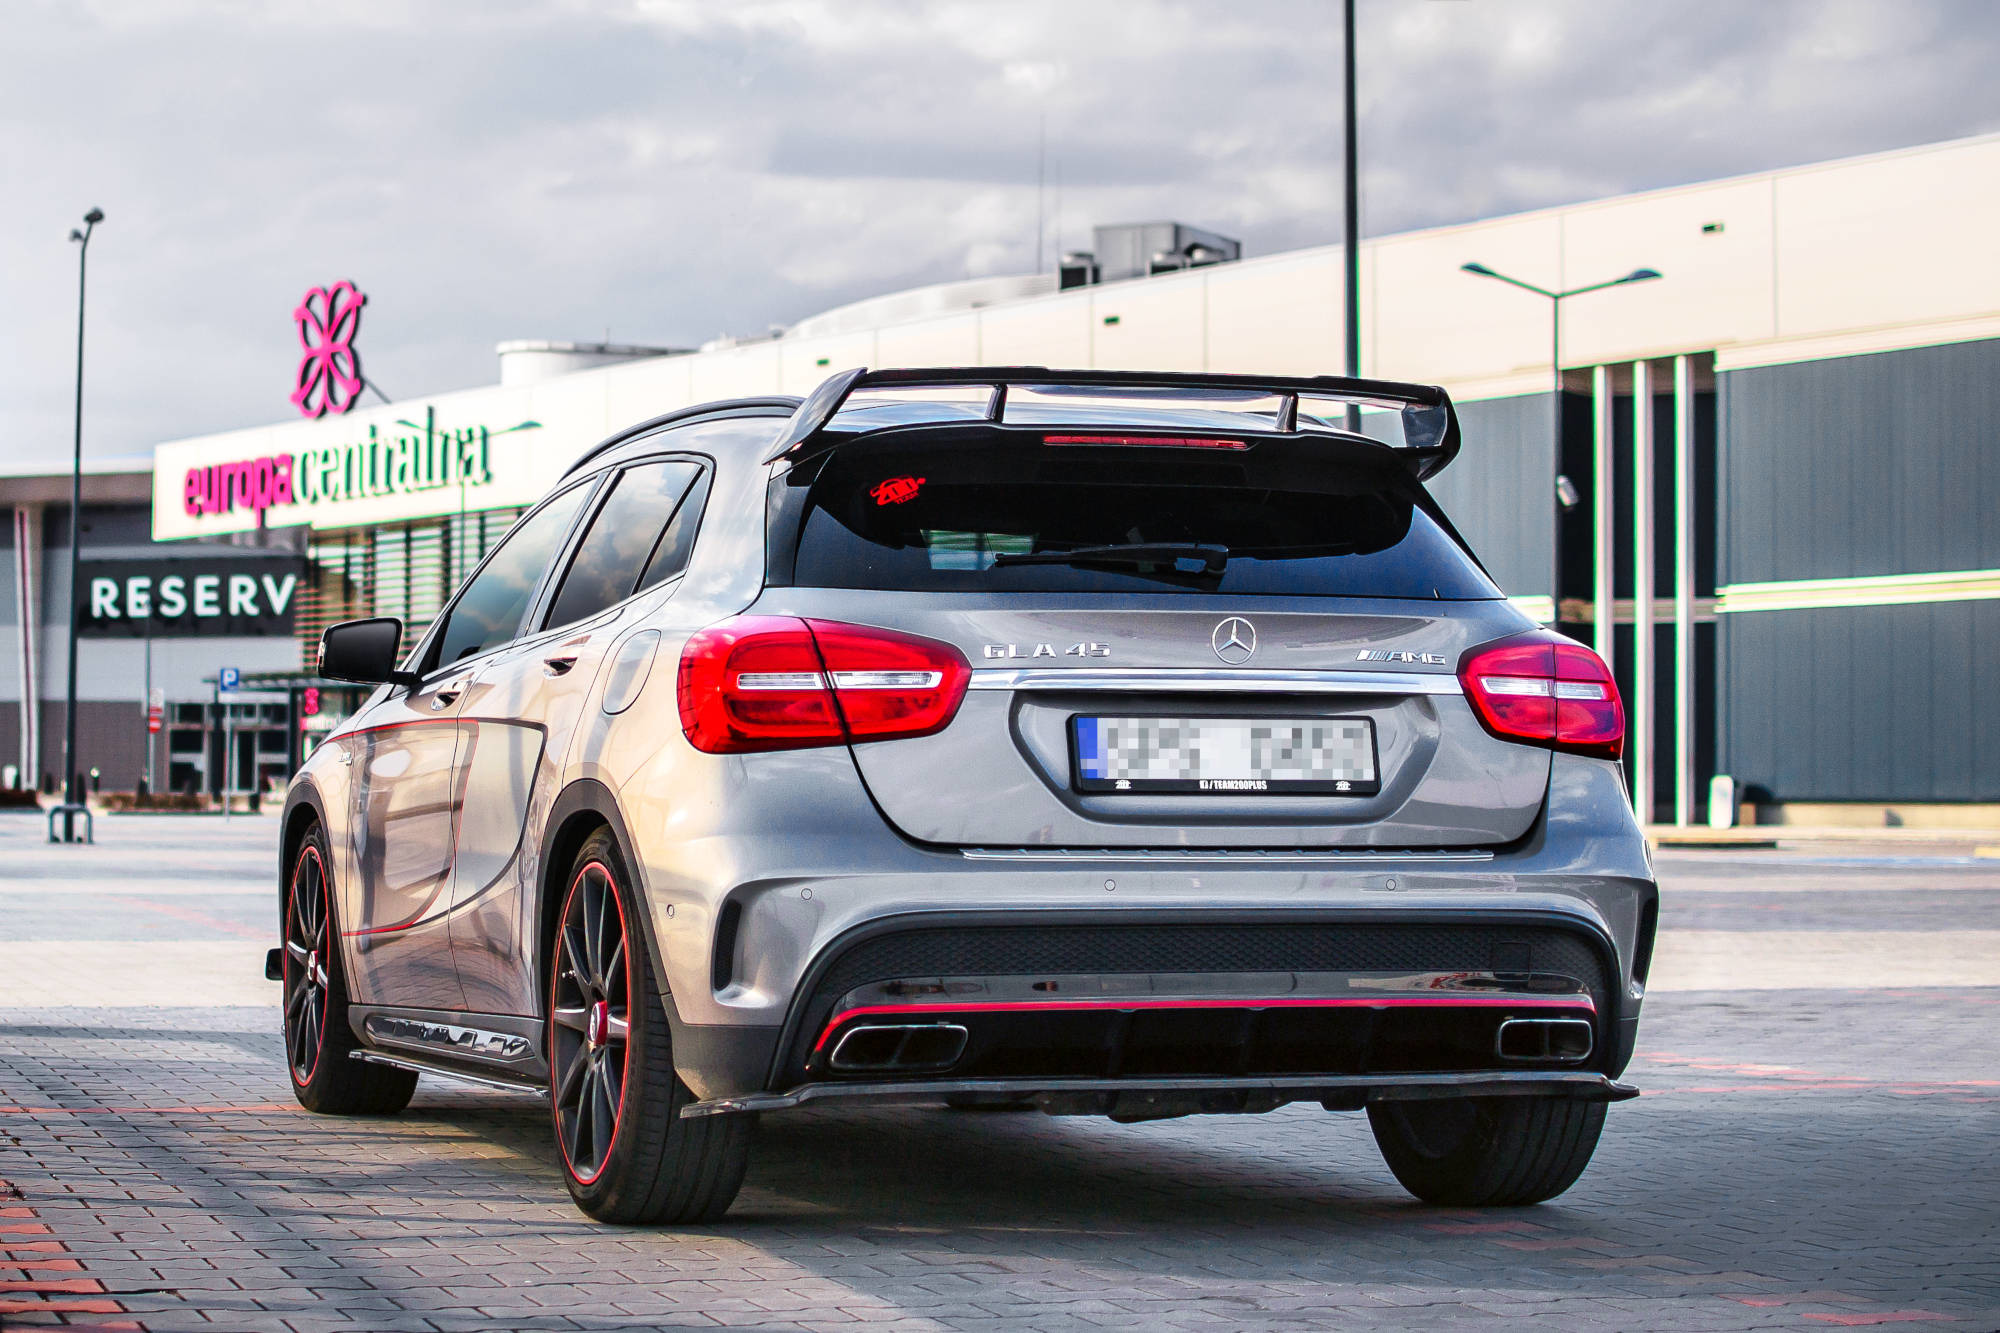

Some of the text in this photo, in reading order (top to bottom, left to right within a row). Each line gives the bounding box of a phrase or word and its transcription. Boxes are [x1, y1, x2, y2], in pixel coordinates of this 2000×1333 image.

[184, 453, 296, 529] europa
[91, 573, 297, 619] RESERV
[983, 642, 1111, 659] GLA 45
[1385, 650, 1446, 665] AMG
